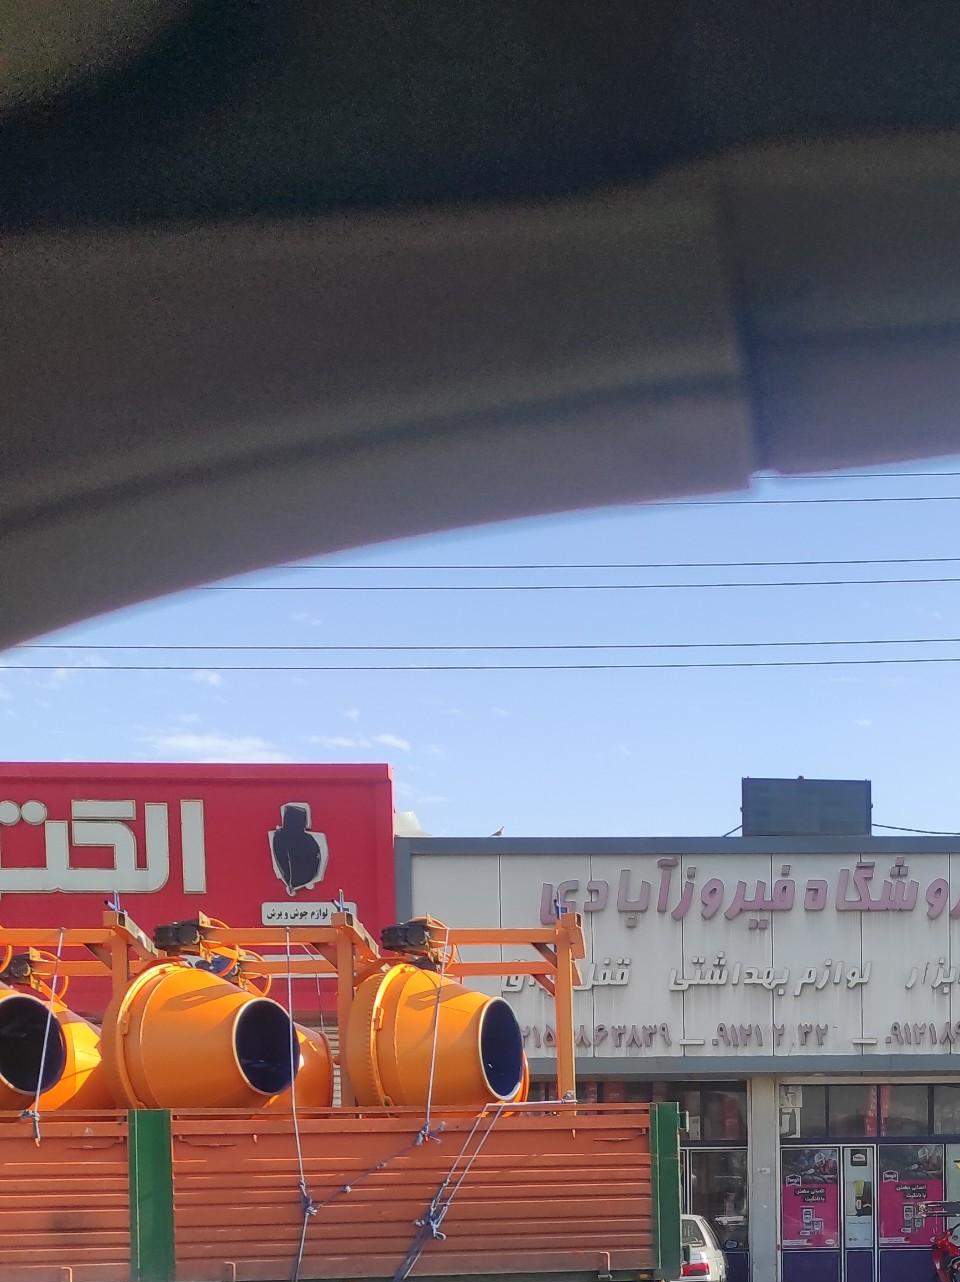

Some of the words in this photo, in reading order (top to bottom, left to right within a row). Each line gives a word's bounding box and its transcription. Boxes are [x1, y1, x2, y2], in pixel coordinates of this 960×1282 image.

[0, 798, 207, 896] الکت
[668, 950, 790, 997] بهداشتی
[793, 957, 872, 998] لوازم
